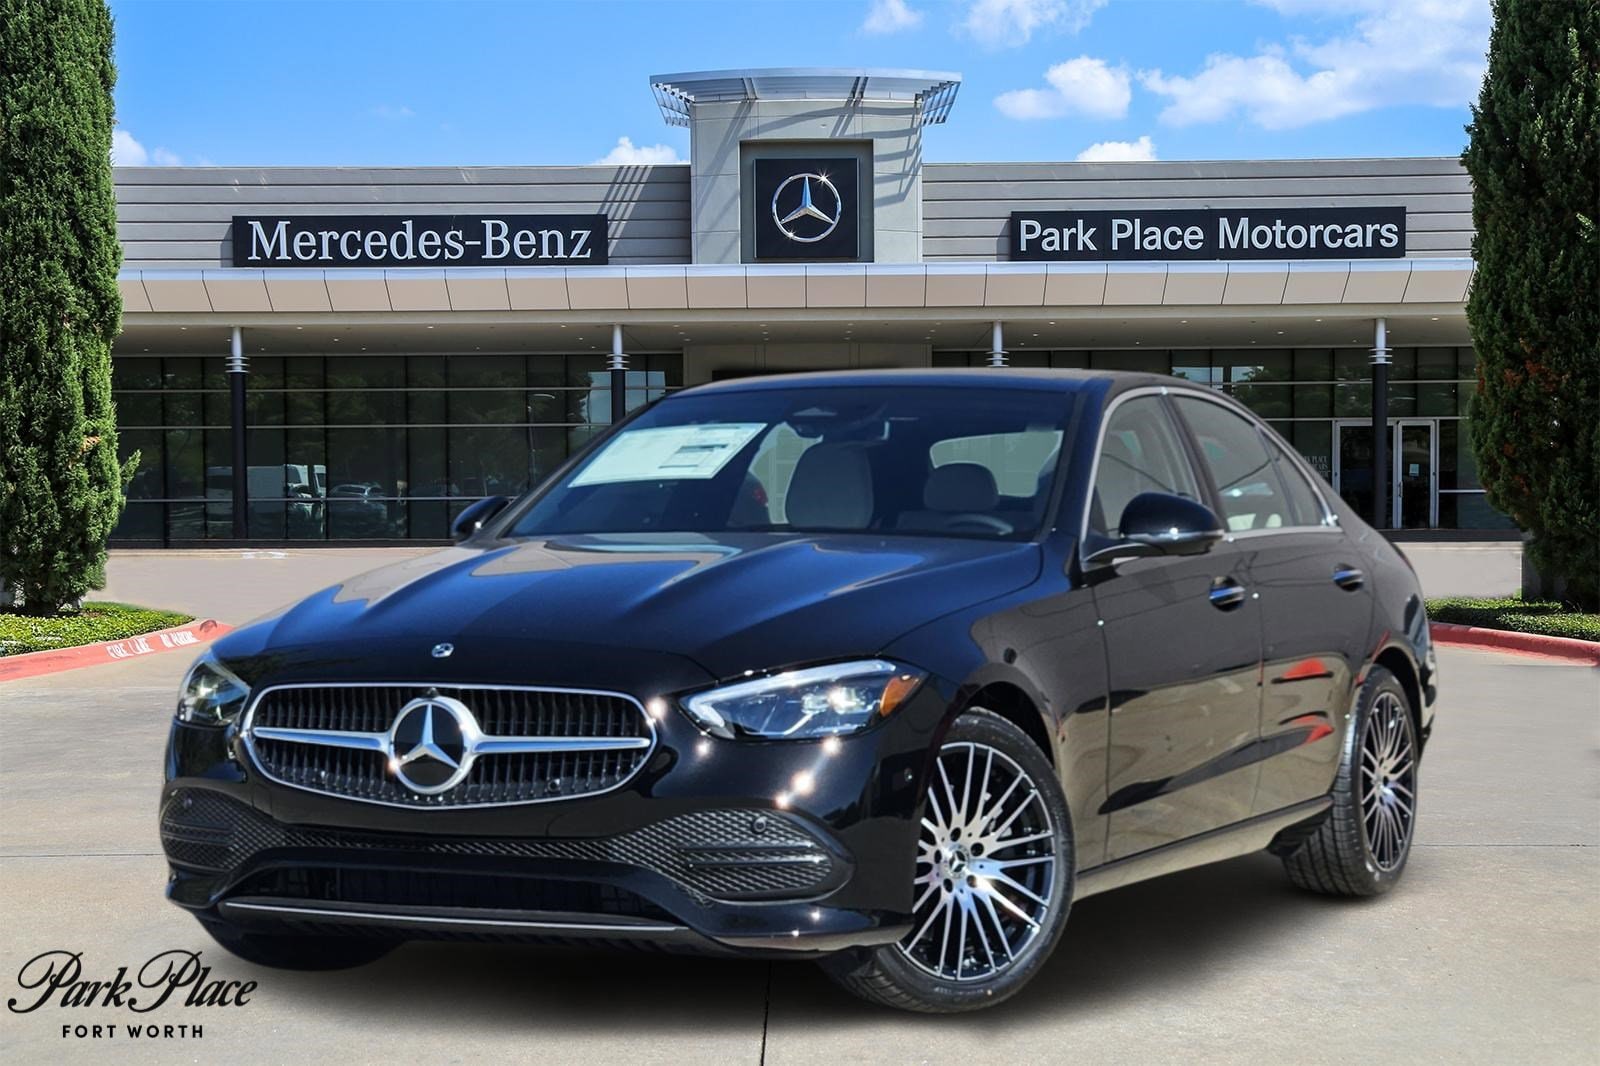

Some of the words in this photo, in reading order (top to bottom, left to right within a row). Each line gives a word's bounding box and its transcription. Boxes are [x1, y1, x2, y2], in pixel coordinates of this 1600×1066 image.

[247, 219, 592, 261] Mercedes-Benz
[1019, 219, 1098, 252] Park
[1111, 218, 1205, 251] Place
[1218, 217, 1399, 249] Motorcars
